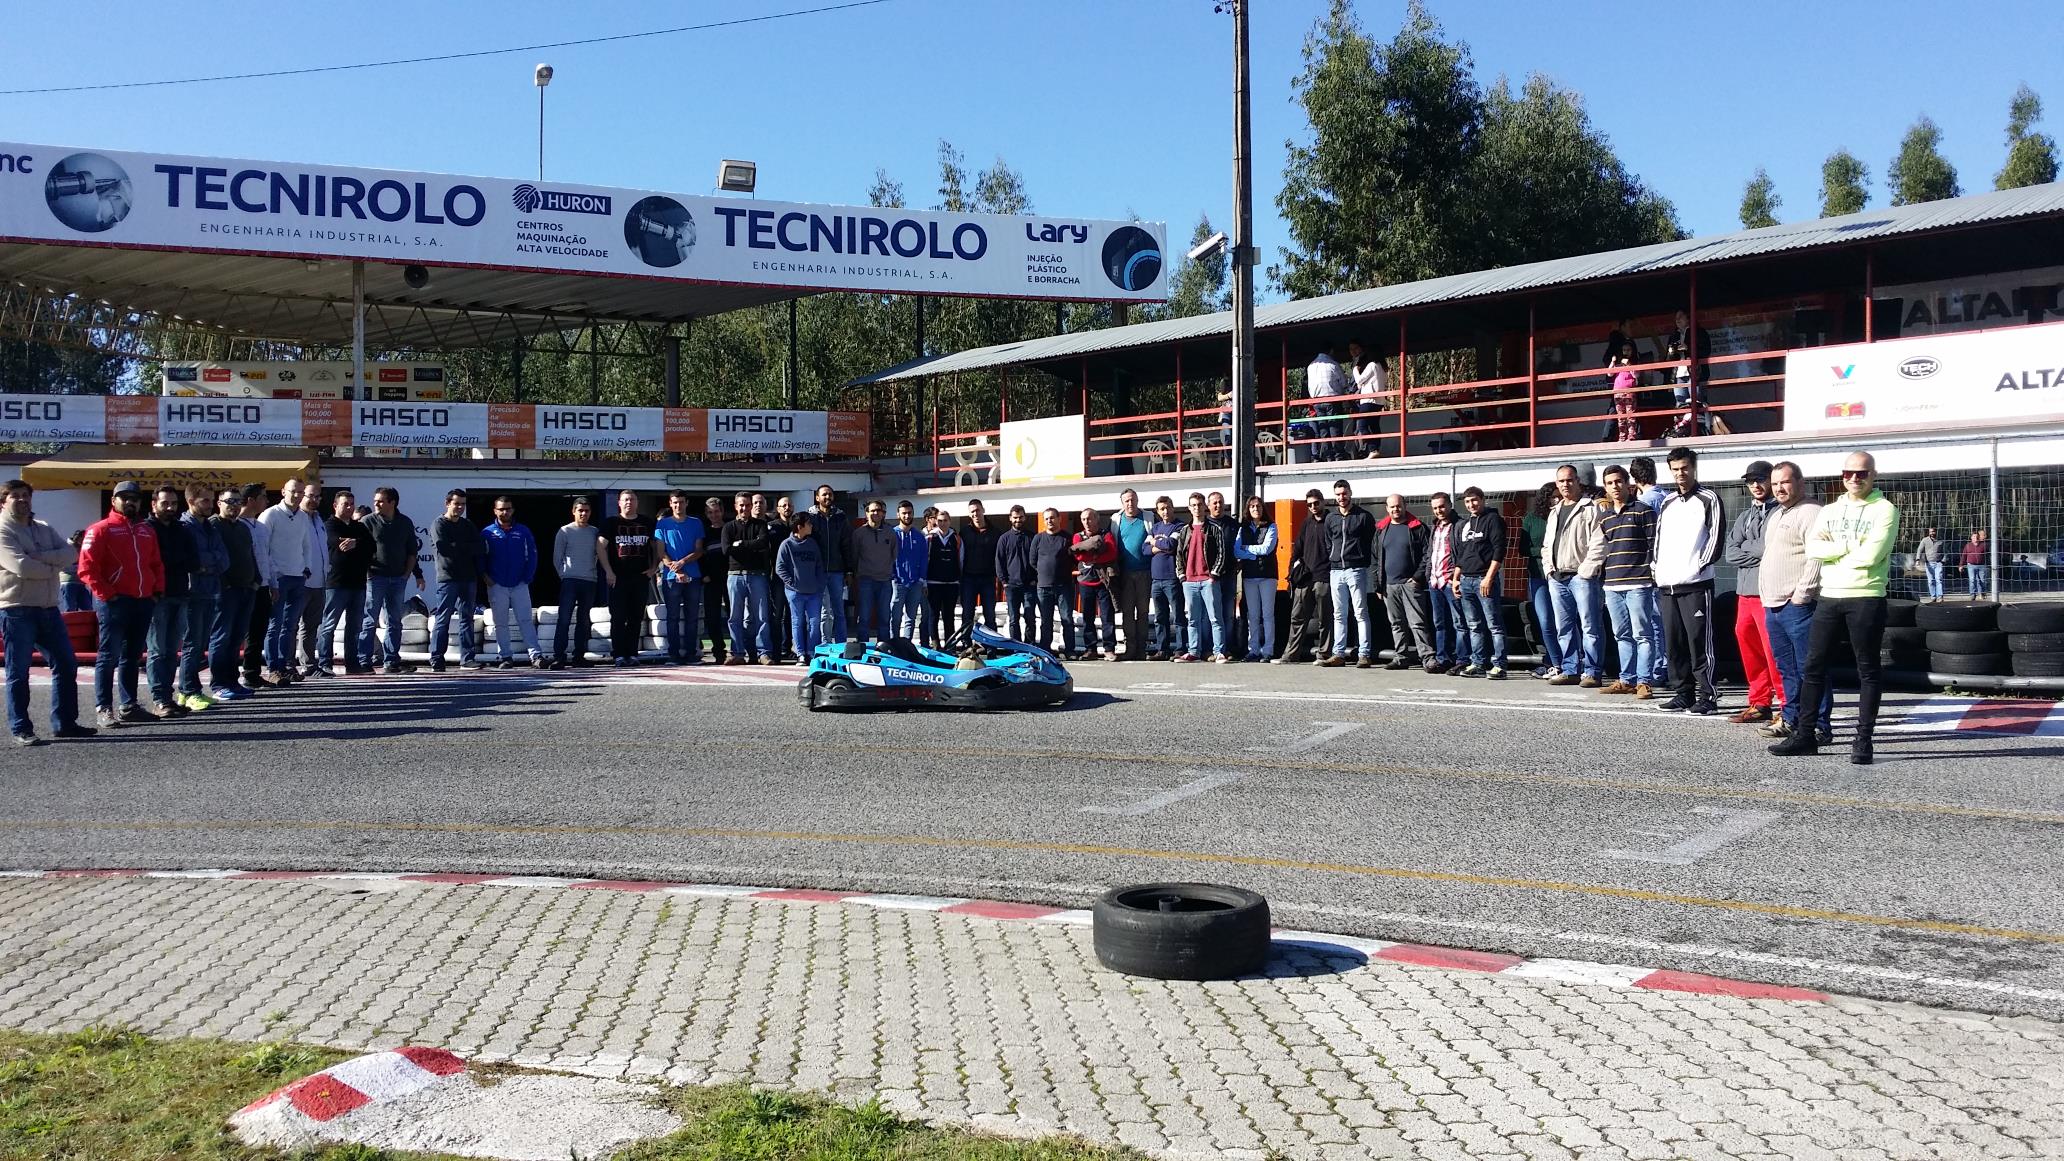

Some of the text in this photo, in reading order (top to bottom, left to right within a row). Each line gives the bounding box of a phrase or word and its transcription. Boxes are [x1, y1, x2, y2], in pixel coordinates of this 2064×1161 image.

[155, 164, 486, 227] TECNIROLO
[548, 194, 606, 213] HURON
[517, 220, 563, 231] CENTROS
[200, 223, 443, 247] ENGENHARIA INDUSTRIAL, S.A.
[517, 232, 587, 246] MAQUINAÇÃO
[714, 207, 988, 261] TECNIROLO
[517, 244, 609, 258] ALTA VELOCIDADE
[1027, 253, 1063, 263] INJEÇÃO
[753, 261, 953, 280] ENGENHARIA INDUSTRIAL, S.A.
[1027, 264, 1067, 274] PLÁSTICO
[1028, 275, 1080, 284] E BORRACHA
[0, 401, 62, 421] SCO
[167, 404, 260, 423] HASCO
[490, 405, 520, 413] Precisão
[360, 407, 449, 427] HASCO
[543, 411, 627, 431] HASCO
[715, 415, 793, 433] HASCO
[22, 428, 45, 438] with
[167, 430, 294, 441] Enabling with System.
[360, 432, 409, 444] Enabling
[412, 434, 435, 443] with
[543, 435, 657, 448] Enabling with System.
[715, 439, 759, 450] Enabling
[761, 440, 781, 449] with
[886, 667, 945, 684] TECNIROLO
